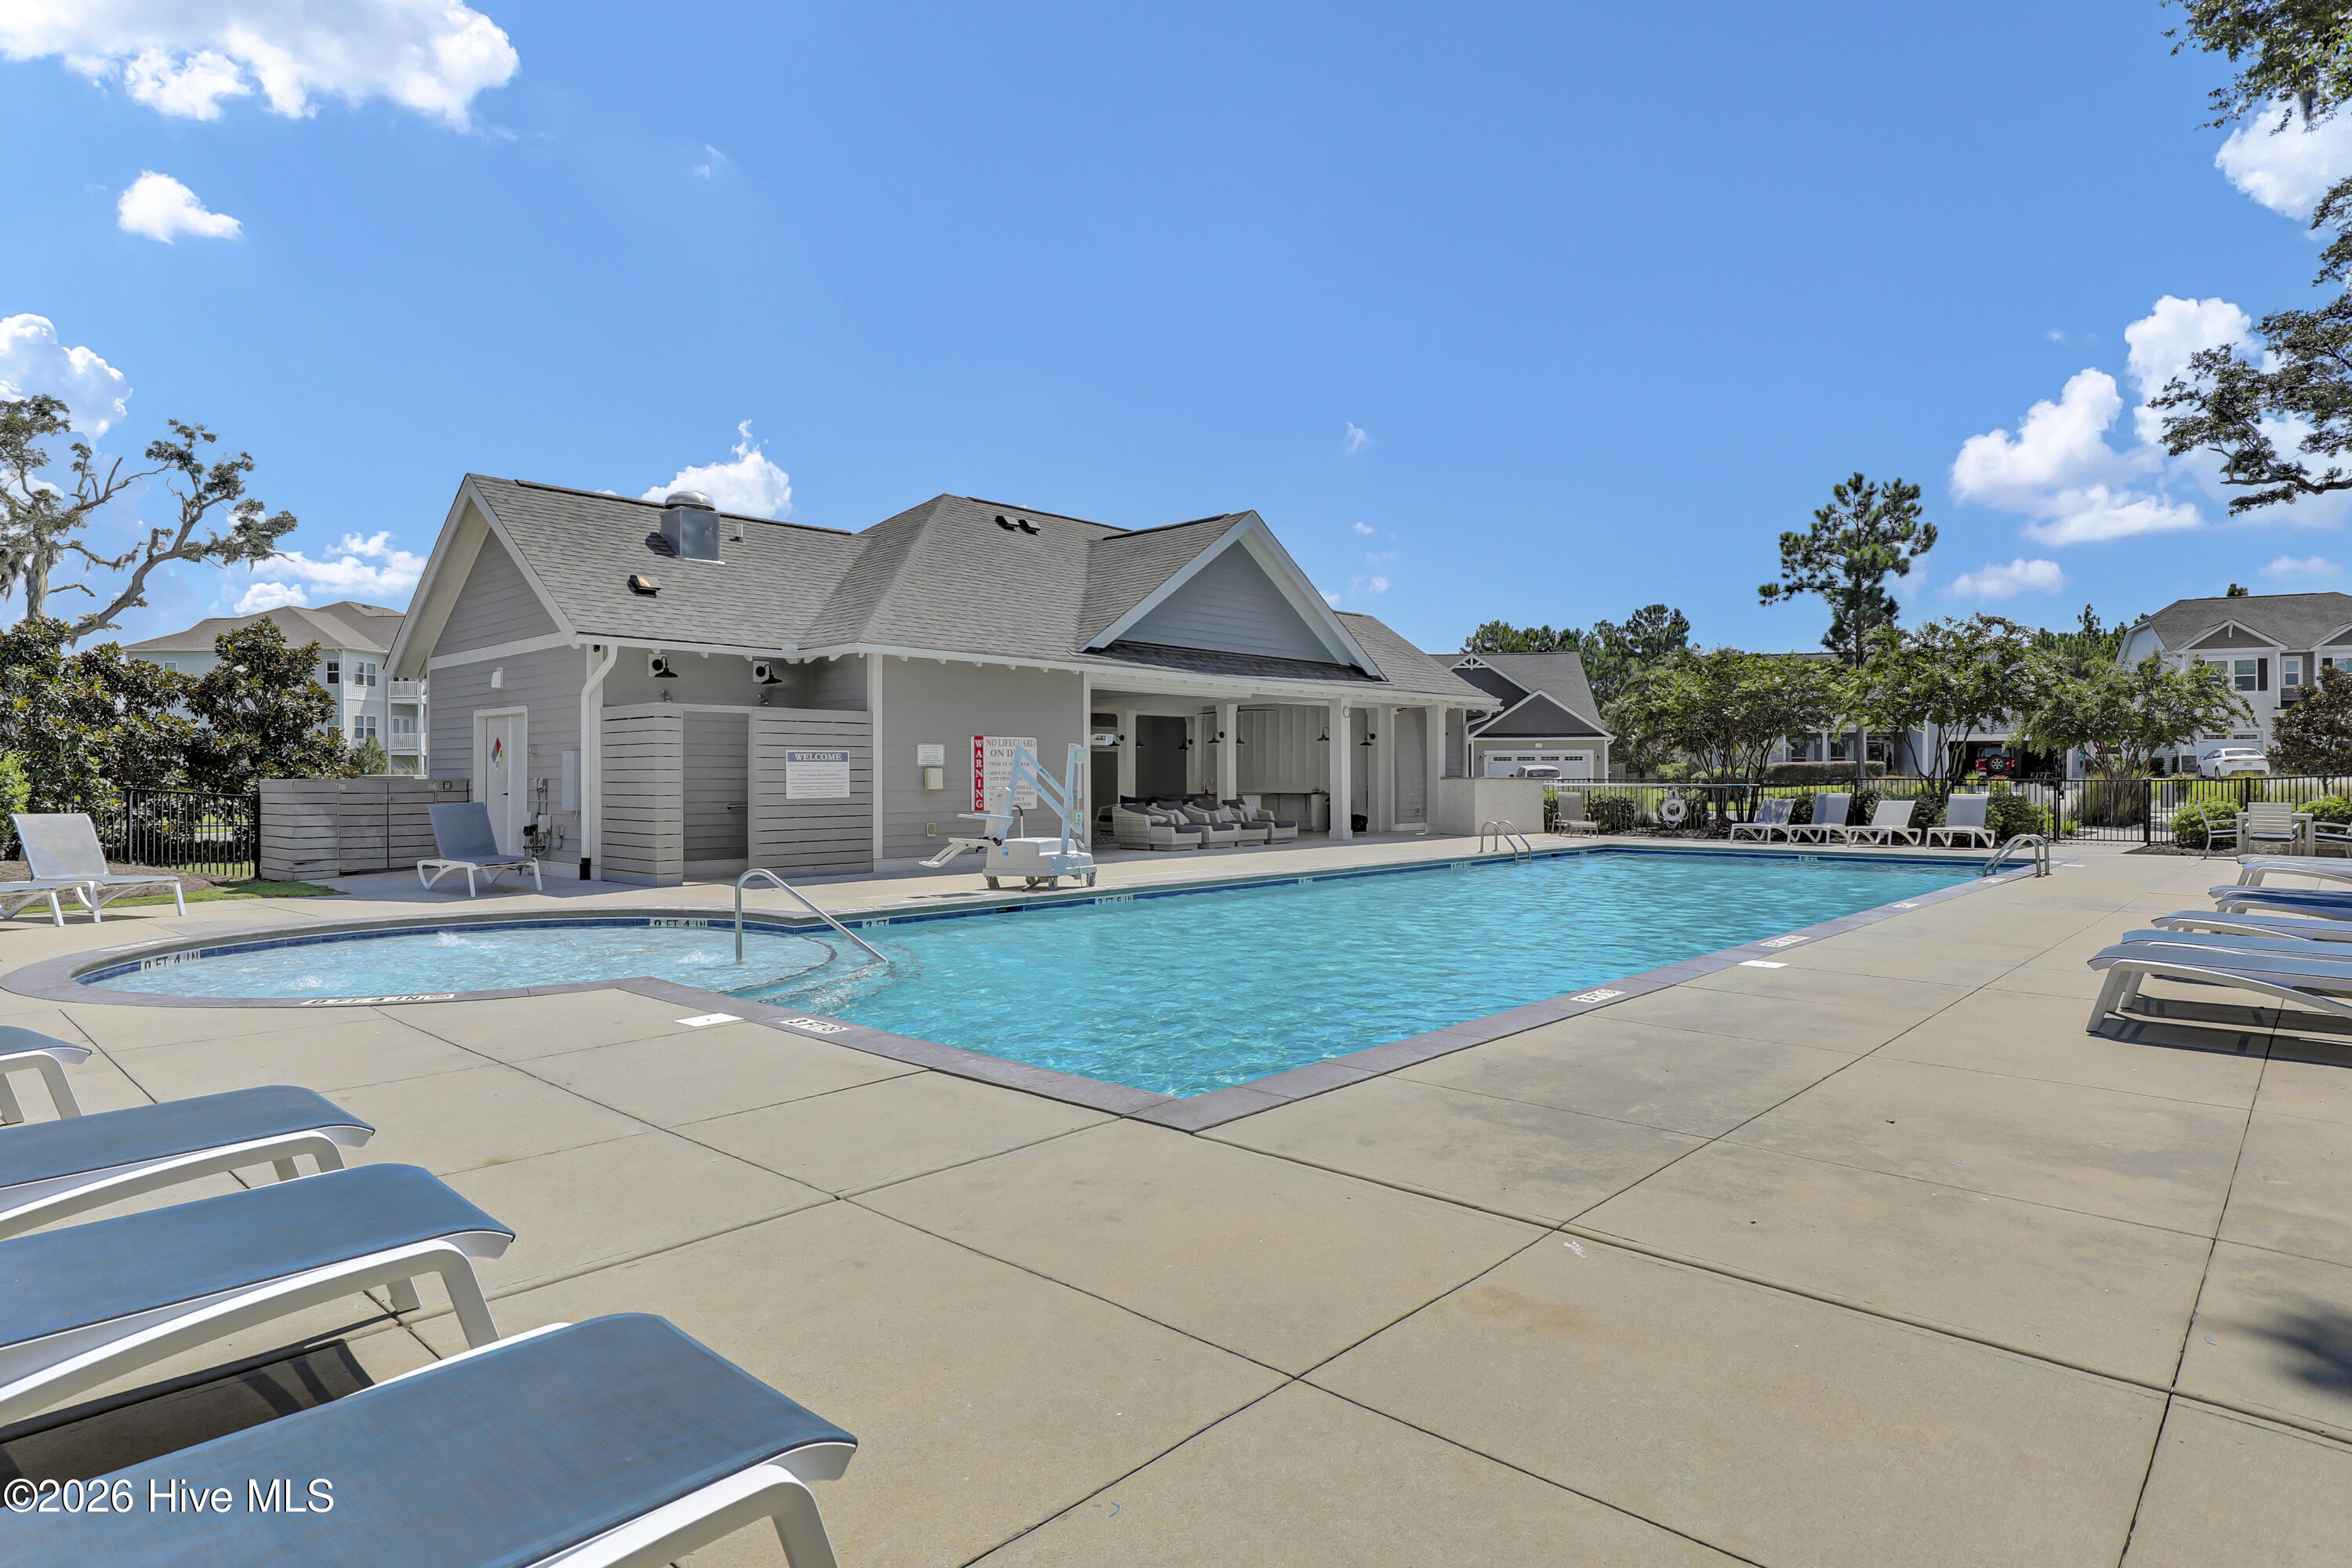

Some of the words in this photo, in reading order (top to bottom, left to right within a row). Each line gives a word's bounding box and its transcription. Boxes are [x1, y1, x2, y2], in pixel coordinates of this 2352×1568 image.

[794, 753, 842, 761] WELCOME
[975, 739, 983, 808] WARNING
[155, 956, 169, 967] FT
